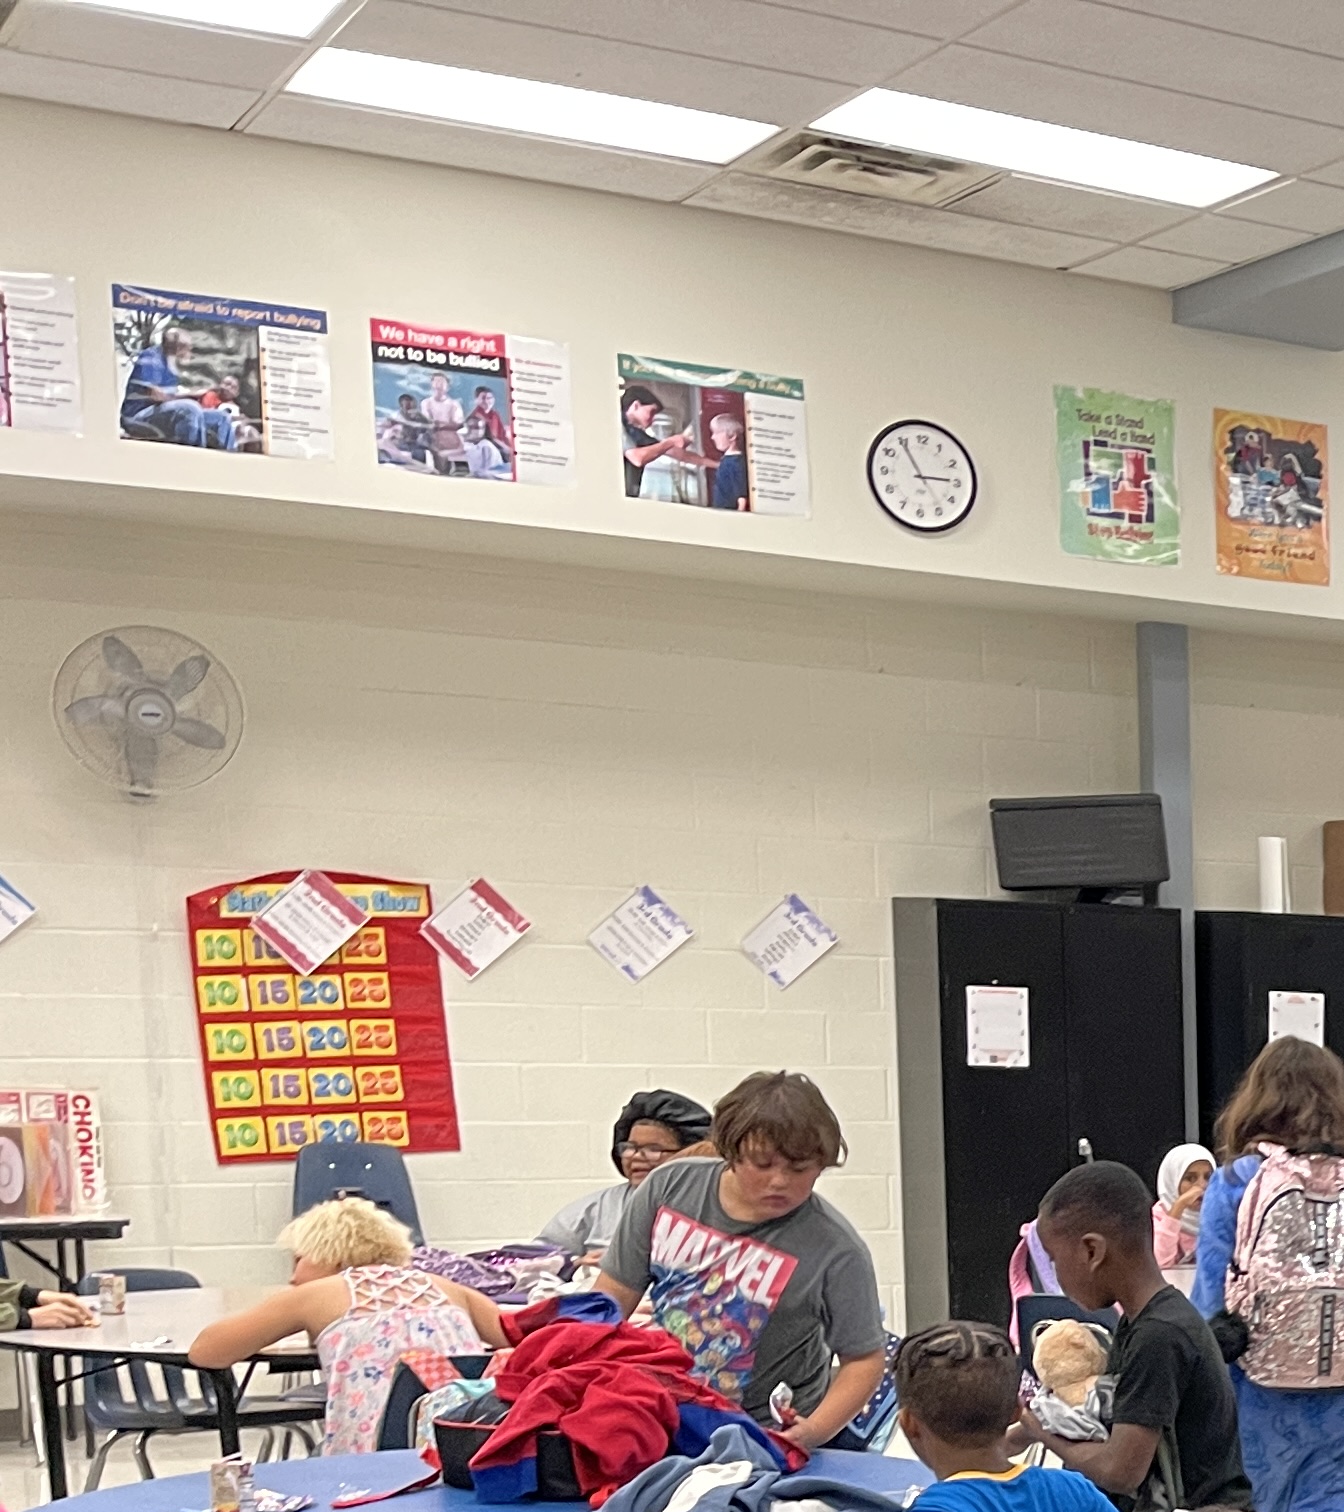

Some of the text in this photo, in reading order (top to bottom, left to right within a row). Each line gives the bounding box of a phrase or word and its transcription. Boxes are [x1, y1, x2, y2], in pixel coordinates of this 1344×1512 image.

[215, 304, 230, 316] to
[231, 307, 271, 322] report
[273, 312, 322, 330] bullying
[378, 324, 497, 354] We have a right
[377, 344, 500, 372] not to be bullied
[1076, 408, 1144, 430] Take a Stand
[916, 434, 930, 446] 12
[1092, 425, 1117, 440] Lend
[1119, 431, 1128, 442] a
[882, 447, 896, 458] 10
[948, 459, 957, 469] 2
[952, 478, 961, 488] 3
[899, 500, 908, 510] 7
[947, 495, 956, 504] 4
[1271, 545, 1316, 560] friend
[371, 890, 421, 913] Show
[320, 904, 347, 929] Grade
[486, 911, 510, 935] Grade
[650, 916, 673, 940] Grade
[203, 934, 238, 960] 10
[344, 932, 382, 958] 25
[797, 924, 818, 947] Grade
[203, 977, 386, 1007] 10 15 20 25
[212, 1024, 392, 1054] 10 15 20 25
[219, 1070, 399, 1102] 10 15 20 25
[224, 1116, 404, 1149] 10 15 20 25
[651, 1211, 785, 1310] MARVEL
